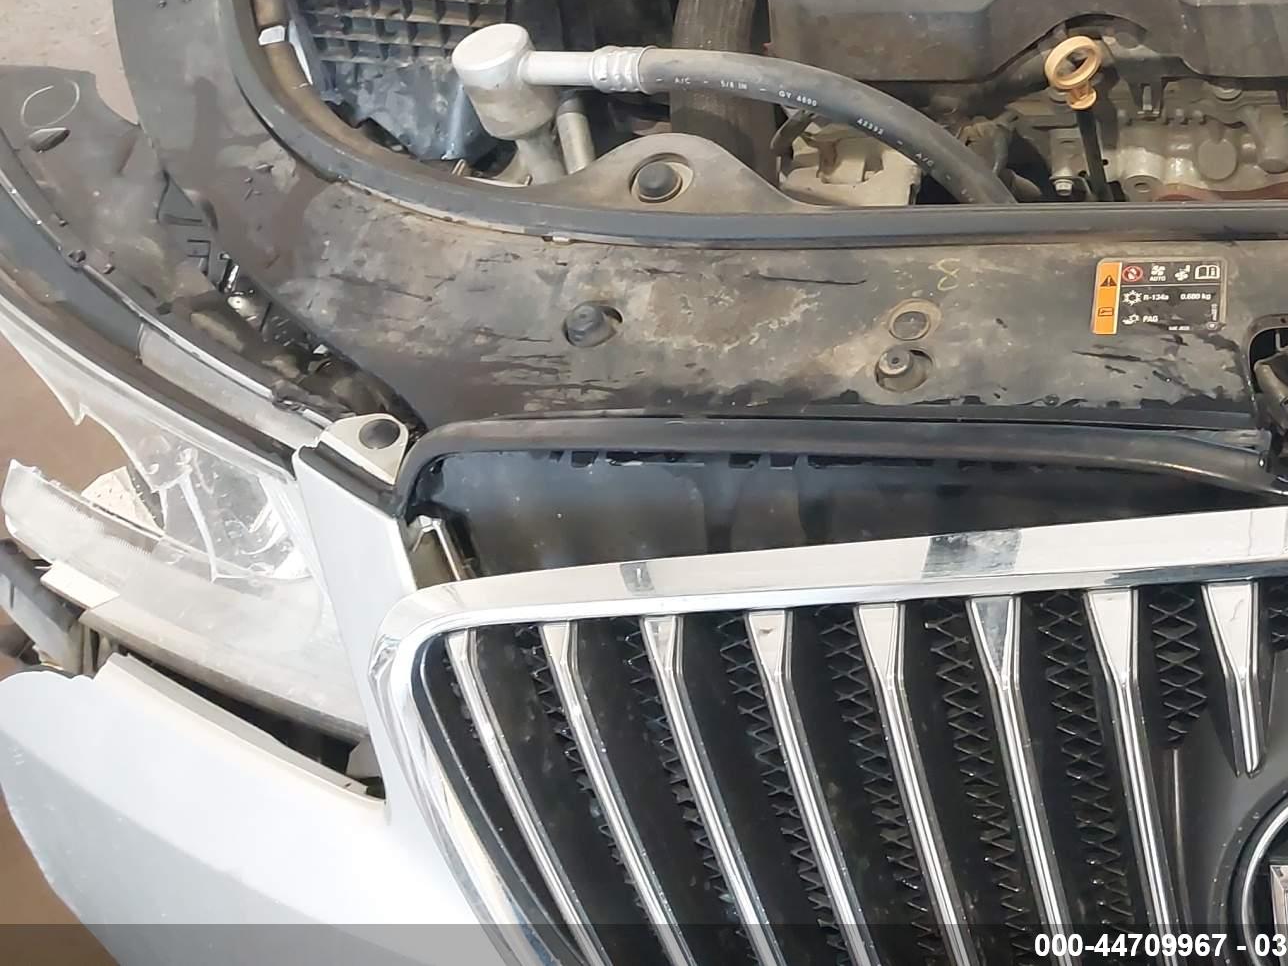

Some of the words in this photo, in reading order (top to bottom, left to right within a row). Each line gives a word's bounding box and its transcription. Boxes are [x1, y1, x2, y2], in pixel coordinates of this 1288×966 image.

[1143, 293, 1169, 301] R-134a
[1201, 292, 1212, 301] kg
[1142, 315, 1159, 323] PAG
